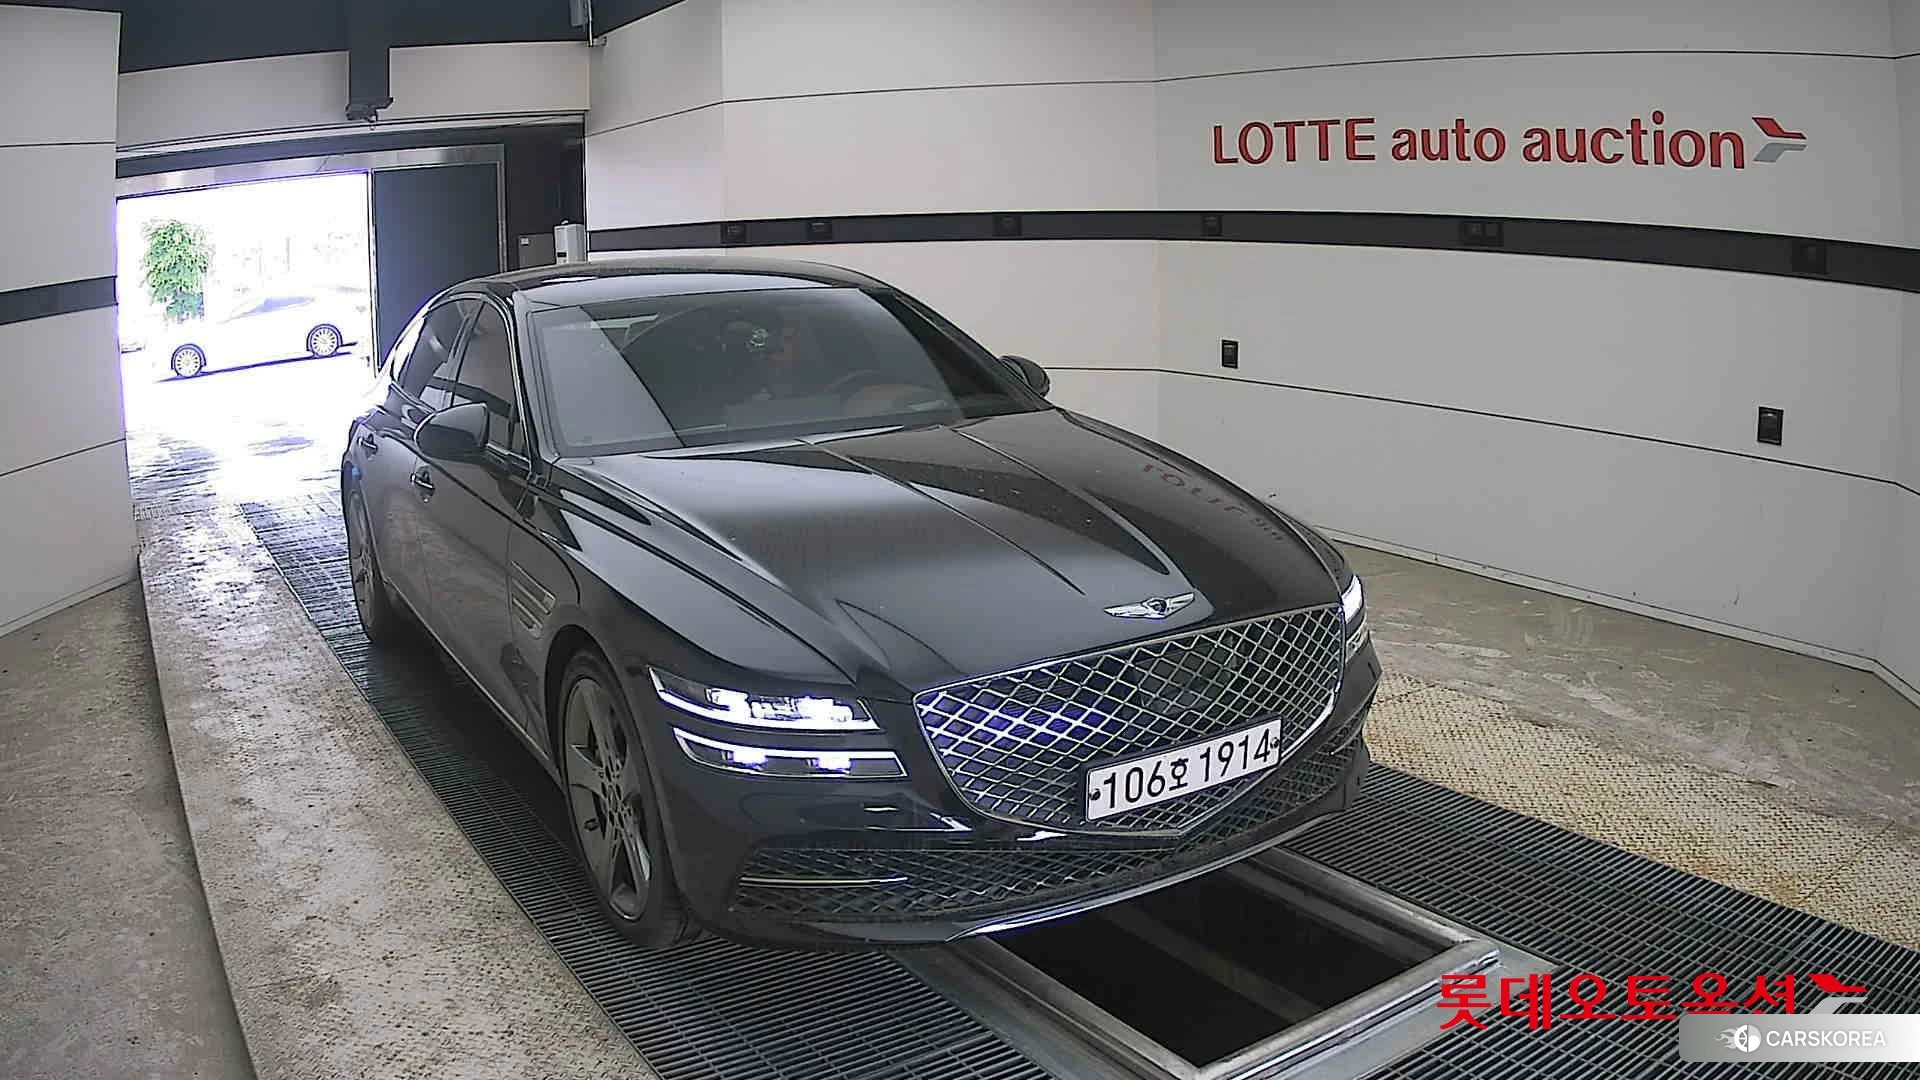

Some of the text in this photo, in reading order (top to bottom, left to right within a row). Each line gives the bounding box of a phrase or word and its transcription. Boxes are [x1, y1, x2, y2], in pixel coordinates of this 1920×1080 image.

[1213, 110, 1745, 169] LOTTE auto auction
[1103, 728, 1271, 809] 106호 1914
